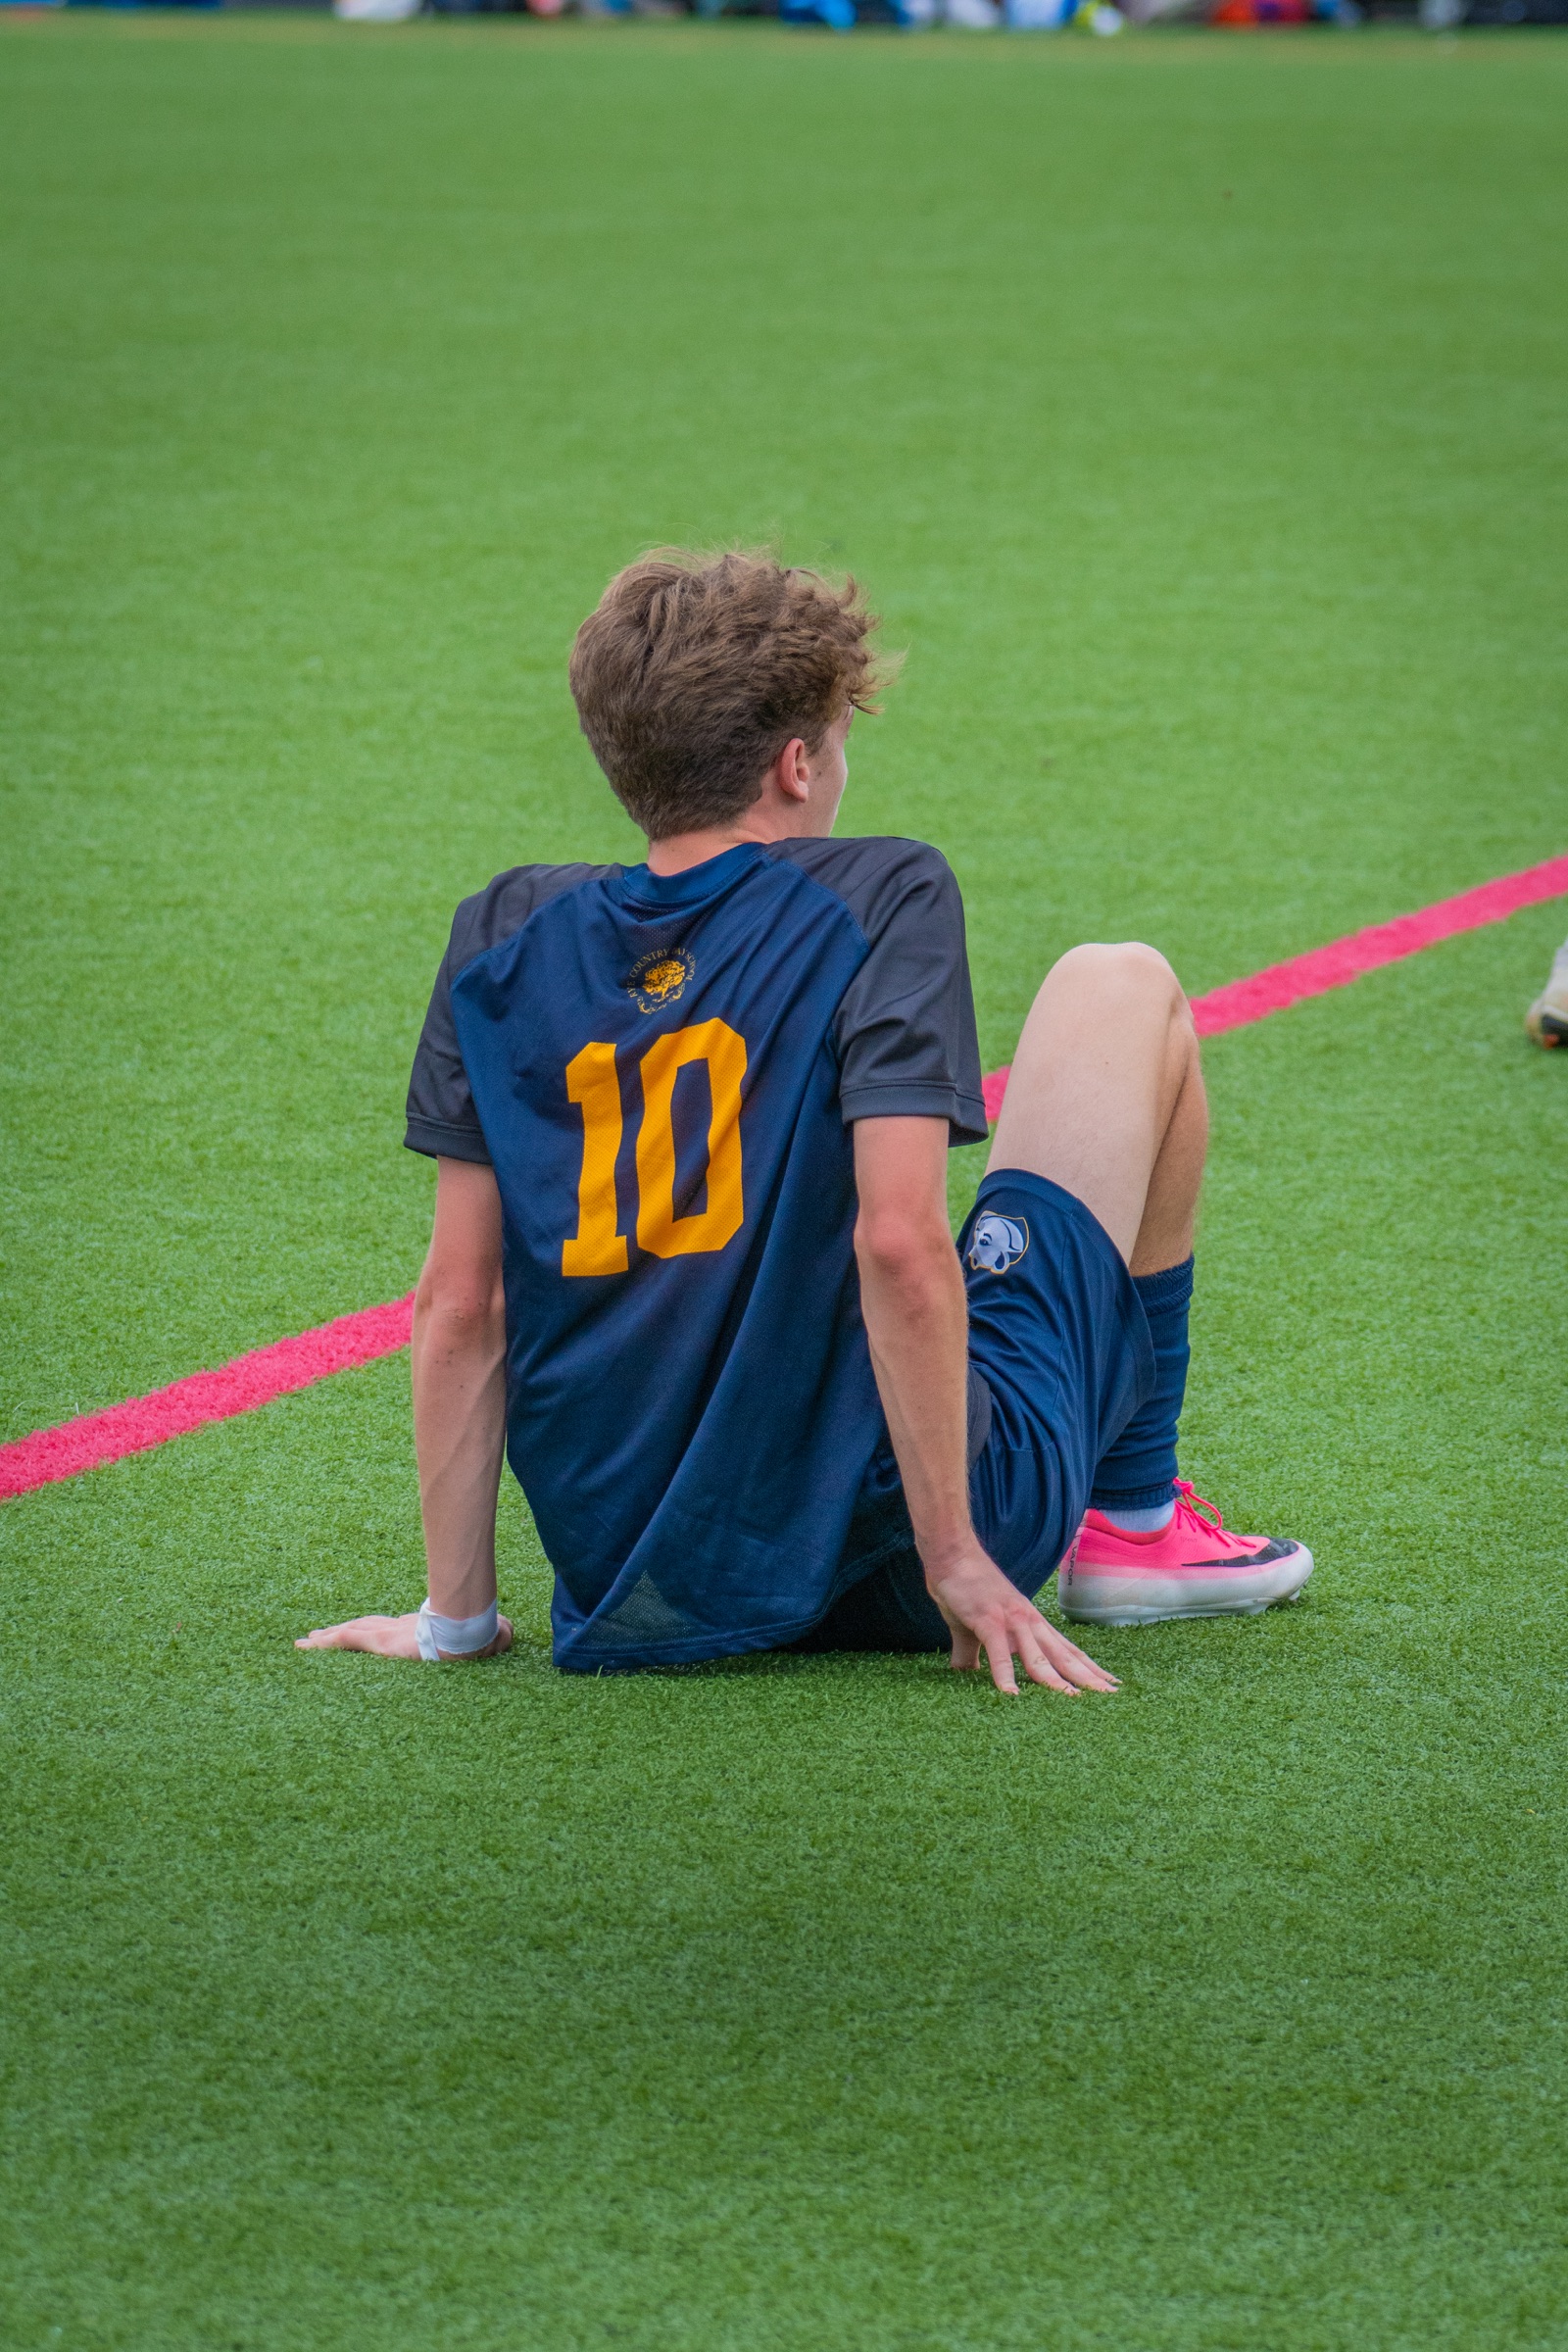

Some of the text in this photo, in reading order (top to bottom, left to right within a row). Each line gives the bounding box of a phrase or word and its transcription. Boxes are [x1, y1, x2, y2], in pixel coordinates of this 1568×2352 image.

[629, 949, 668, 977] COUNTRY
[562, 1017, 748, 1277] 10
[1067, 1545, 1077, 1586] VAPOR
